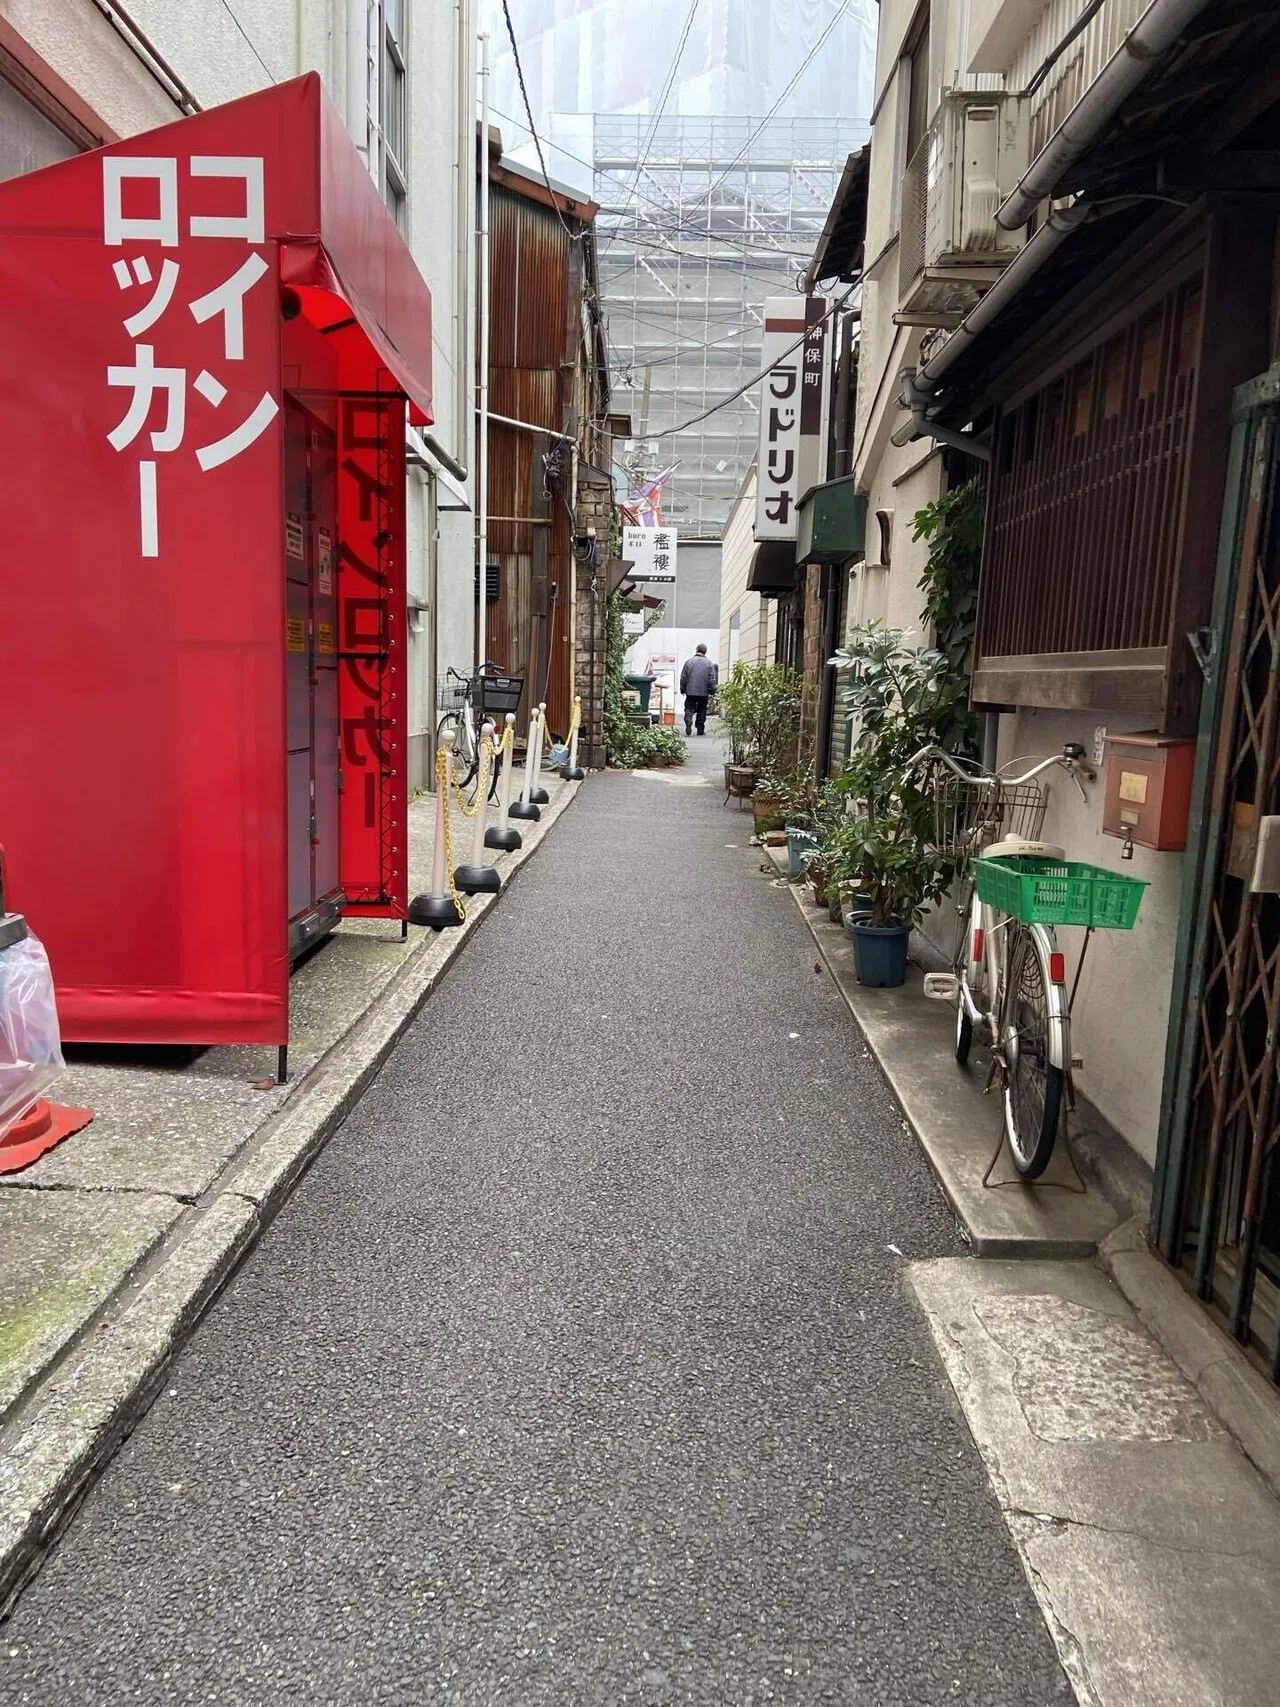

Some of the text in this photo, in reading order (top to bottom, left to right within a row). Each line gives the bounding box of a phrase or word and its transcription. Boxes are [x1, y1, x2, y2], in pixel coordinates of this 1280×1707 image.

[102, 156, 186, 557] ロッカー
[188, 155, 279, 472] コイン
[804, 325, 823, 387] 神保町
[765, 365, 797, 524] ラドリオ
[628, 532, 646, 540] boro
